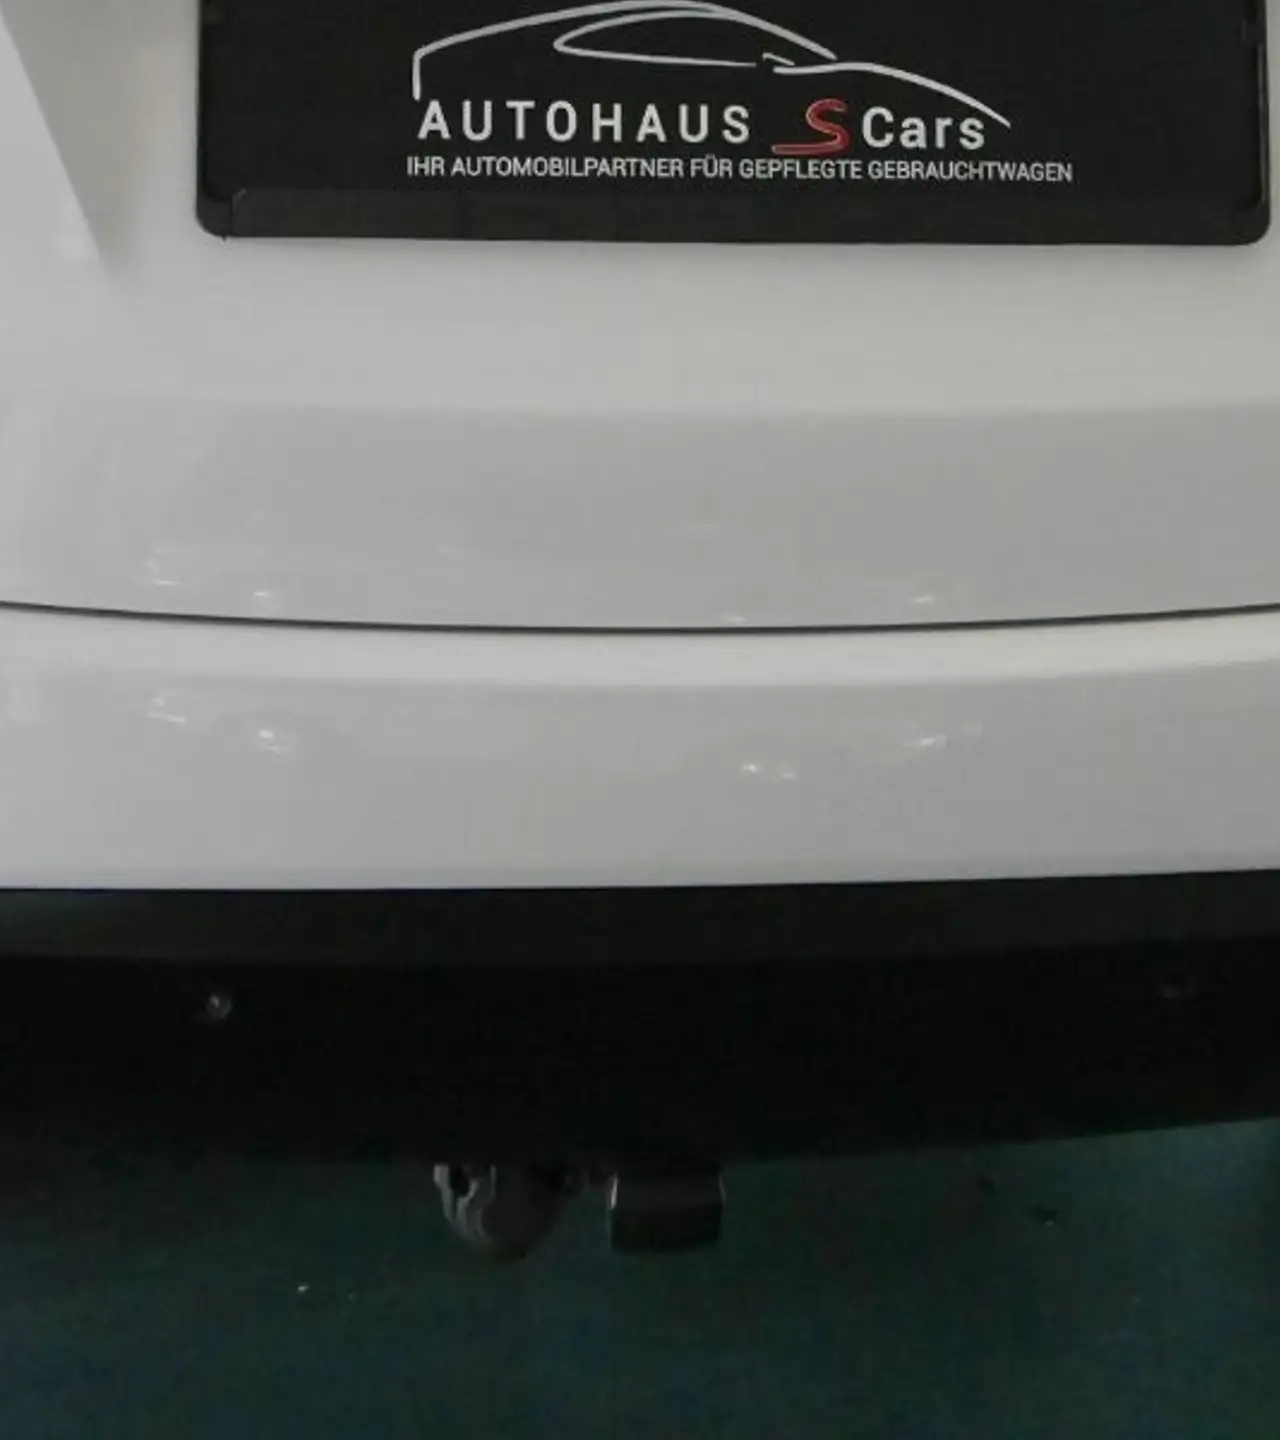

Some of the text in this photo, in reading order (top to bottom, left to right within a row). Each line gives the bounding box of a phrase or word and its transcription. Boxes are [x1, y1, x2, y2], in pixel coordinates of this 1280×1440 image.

[417, 98, 986, 156] AUTOHAUS S Cars
[406, 154, 1073, 182] IHR AUTOMOBILPARTNER FÜR GEPFLEGTE GEBRAUCHTWAGEN
